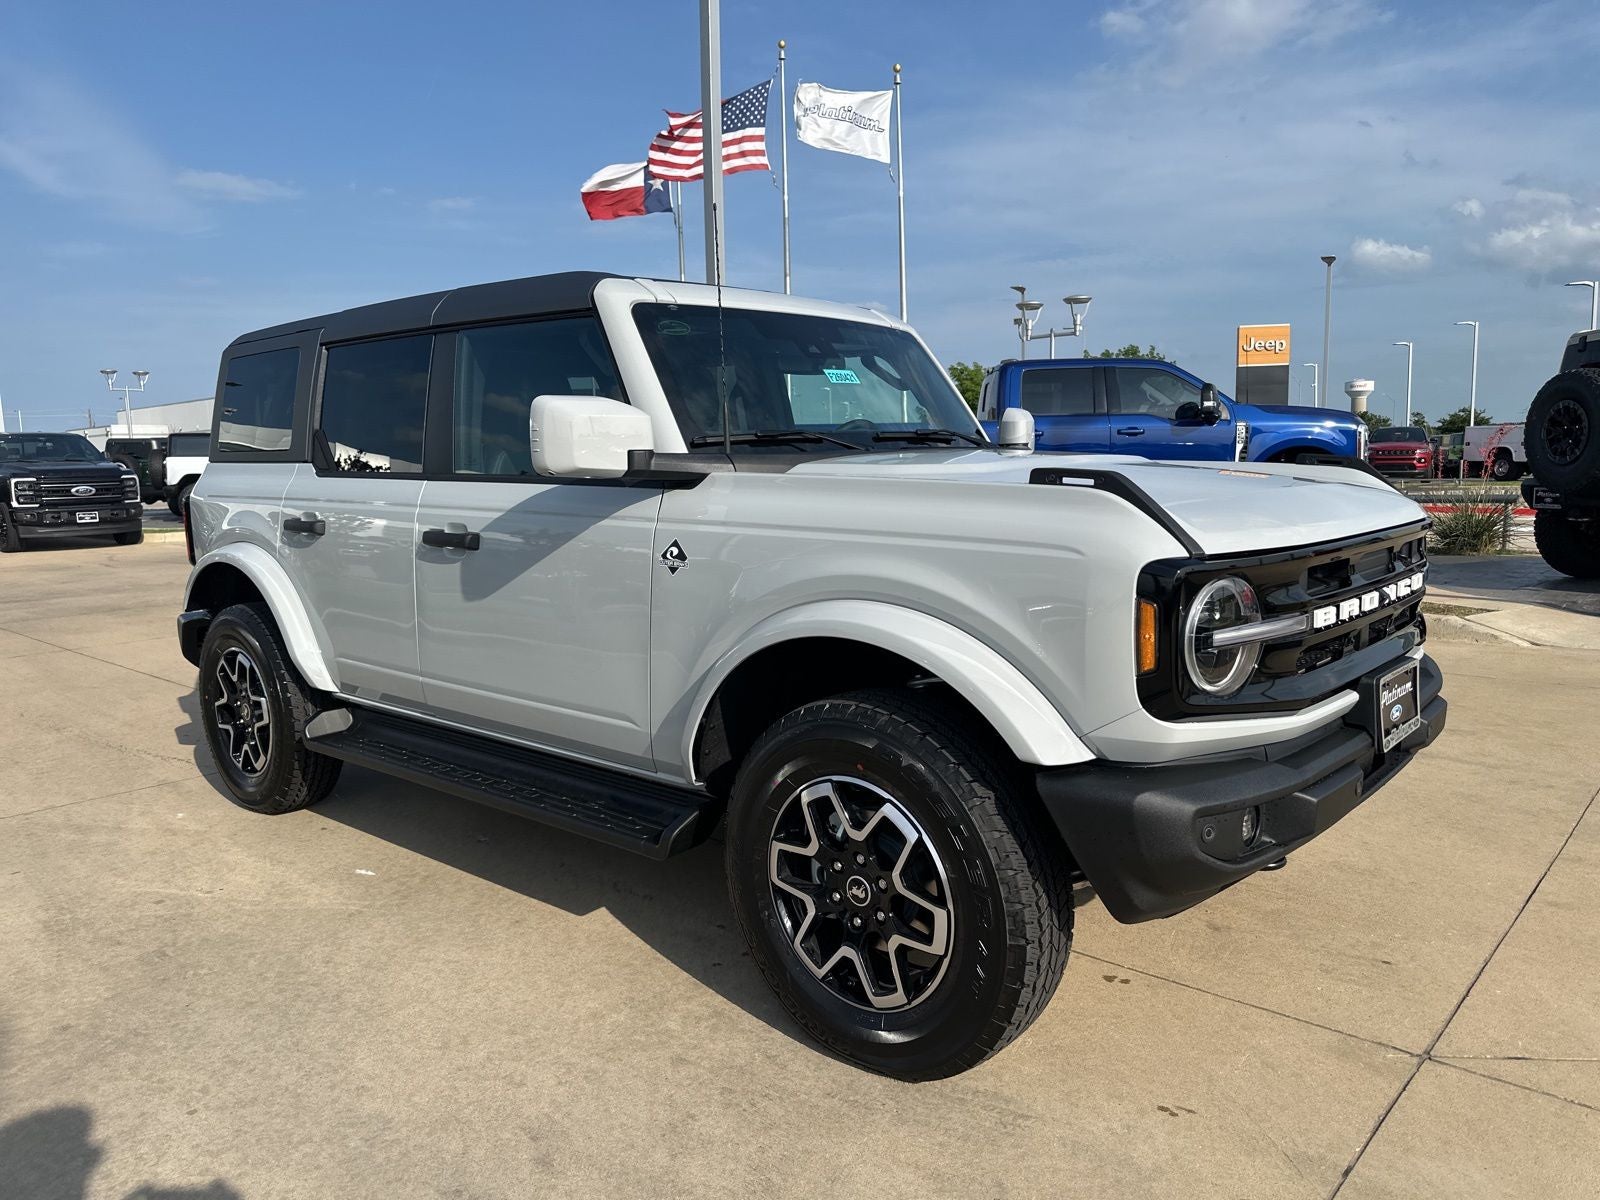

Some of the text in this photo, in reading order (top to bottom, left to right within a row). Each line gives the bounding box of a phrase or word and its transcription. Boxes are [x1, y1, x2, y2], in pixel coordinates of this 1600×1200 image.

[1242, 336, 1287, 354] Jeep
[1313, 572, 1424, 629] BRONCO
[1381, 681, 1413, 708] Platinum
